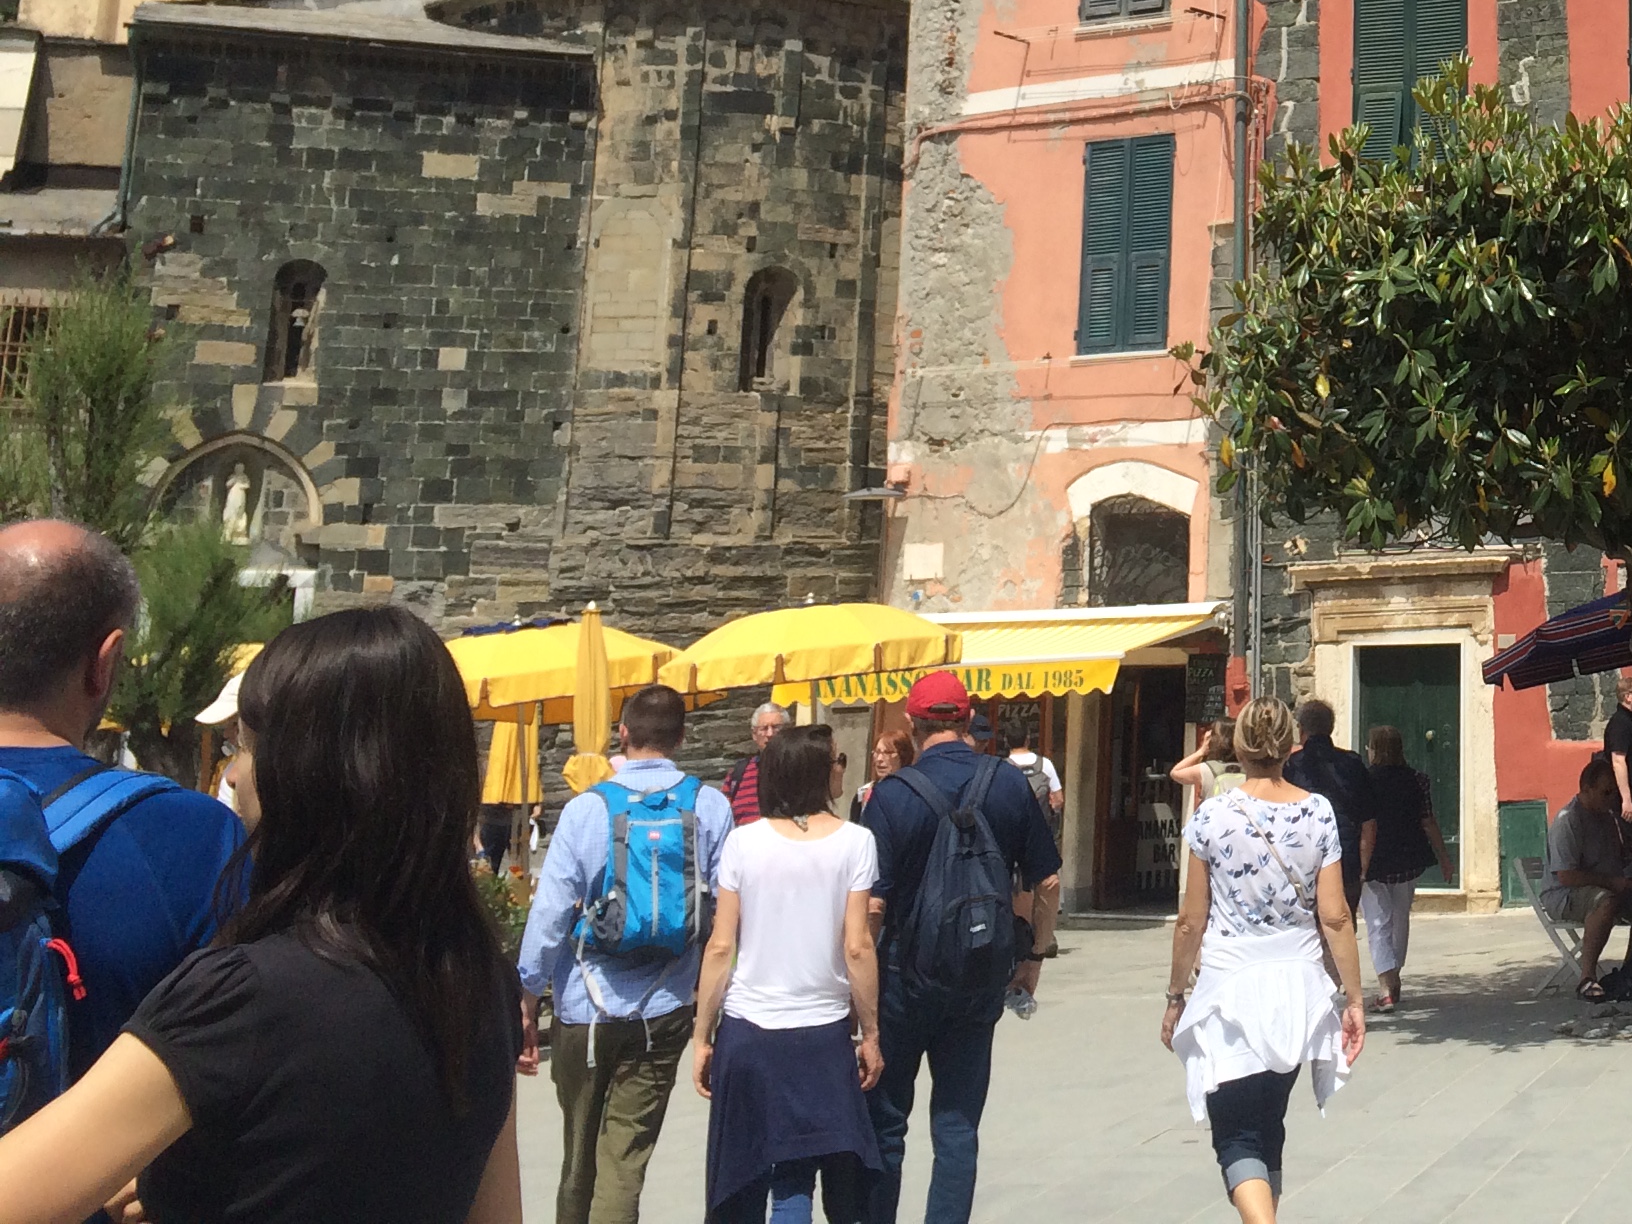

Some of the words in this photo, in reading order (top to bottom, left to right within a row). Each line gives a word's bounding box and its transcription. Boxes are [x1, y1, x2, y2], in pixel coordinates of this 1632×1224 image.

[1001, 672, 1034, 691] DAL
[1044, 669, 1083, 688] 1985
[998, 702, 1041, 719] PIZZA
[1153, 843, 1176, 863] BAR
